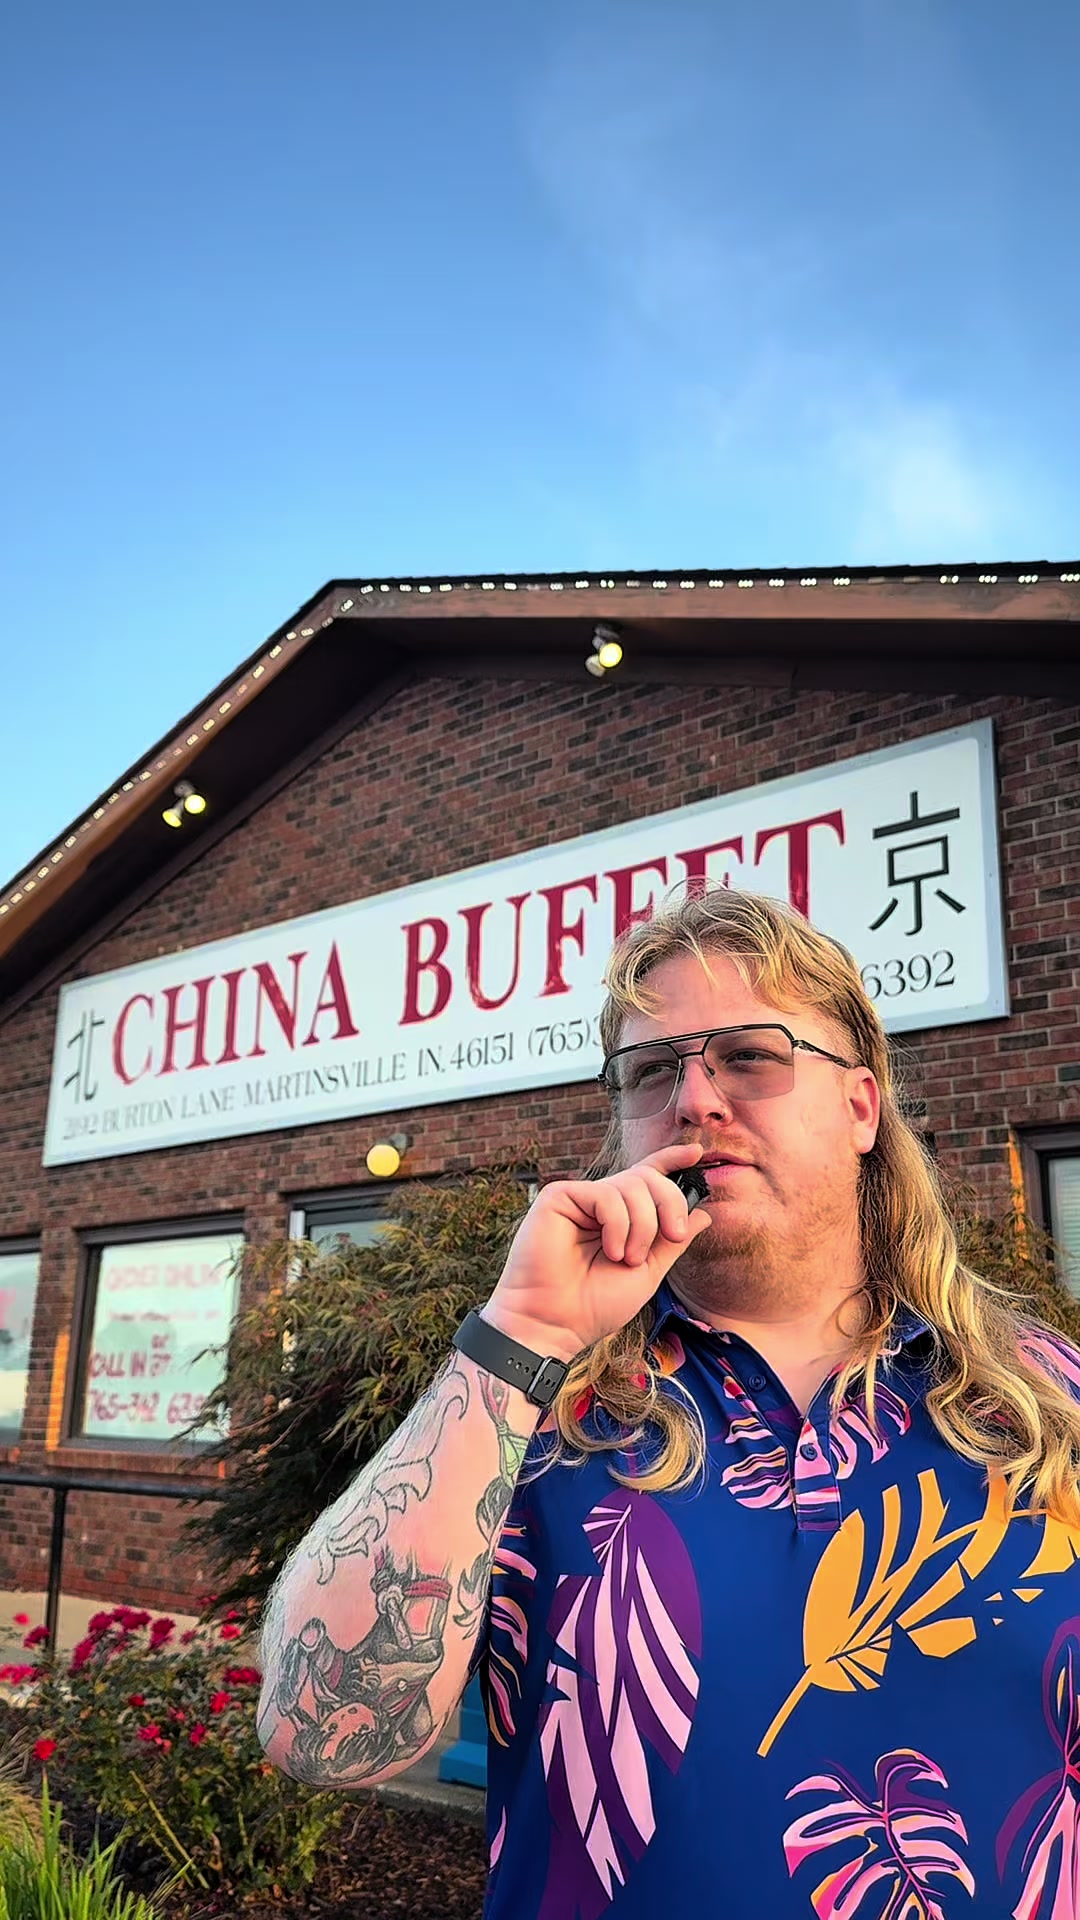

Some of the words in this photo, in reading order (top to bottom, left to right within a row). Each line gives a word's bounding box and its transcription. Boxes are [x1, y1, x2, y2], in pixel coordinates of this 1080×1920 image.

[868, 791, 966, 936] 京
[63, 1009, 105, 1104] 北
[112, 940, 361, 1086] CHINA
[101, 1099, 173, 1134] BURTON
[181, 1085, 236, 1119] LANE
[244, 1052, 407, 1106] MARTINSVILLE
[449, 1031, 514, 1070] 46151
